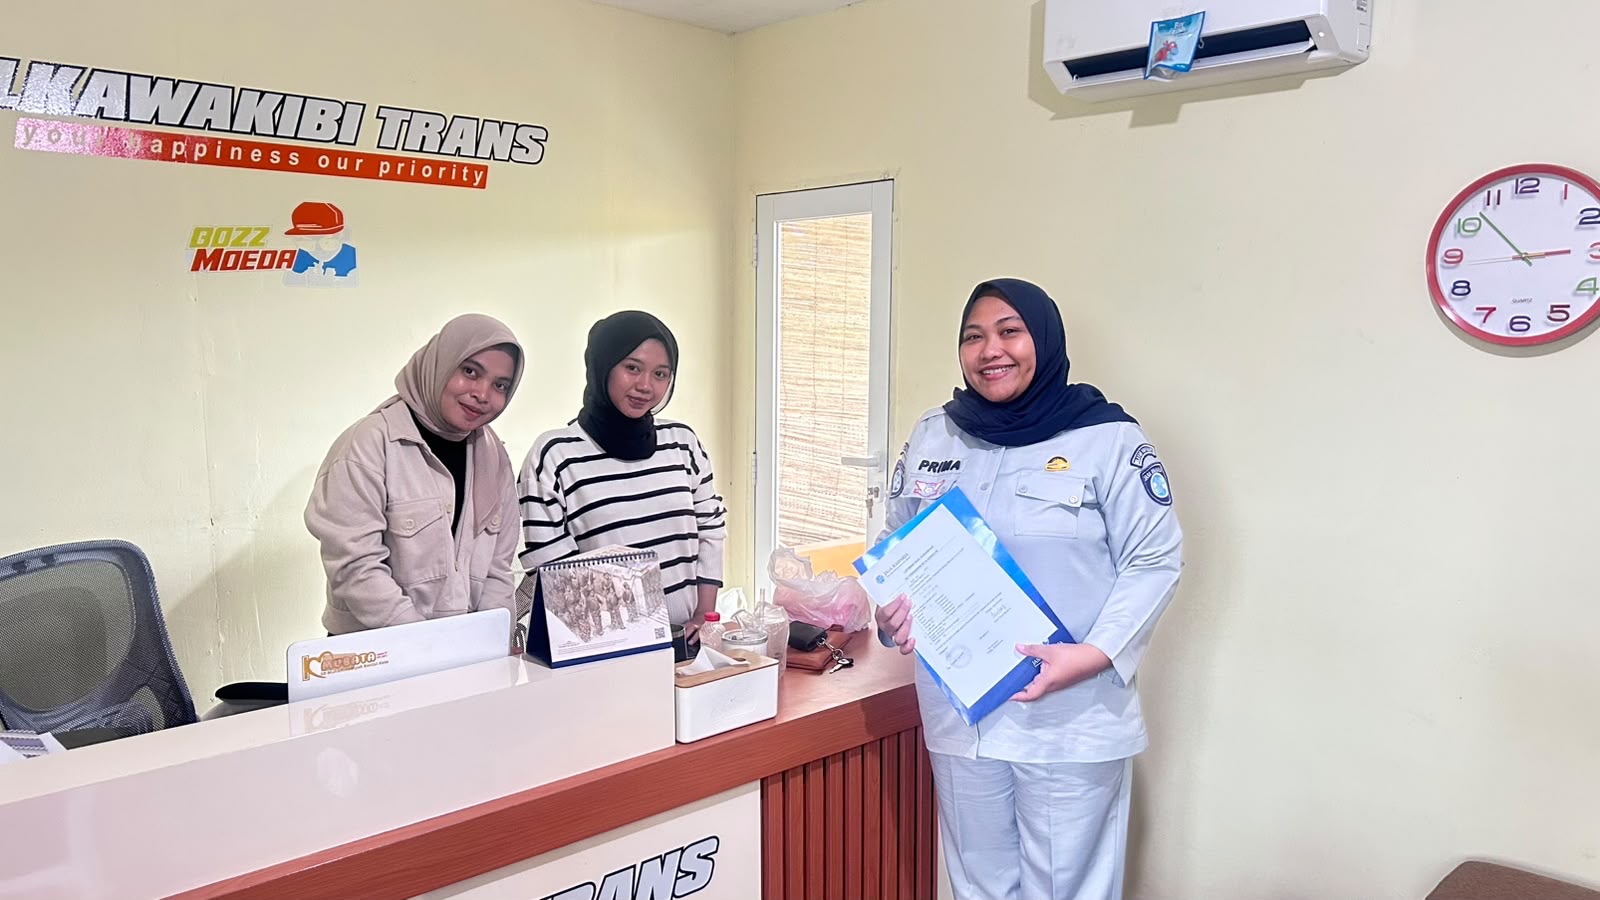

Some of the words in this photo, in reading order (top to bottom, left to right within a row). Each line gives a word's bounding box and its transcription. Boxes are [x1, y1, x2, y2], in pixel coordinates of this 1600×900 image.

[376, 106, 548, 165] TRANS
[125, 129, 300, 165] happiness
[317, 153, 364, 172] our
[379, 160, 484, 187] priority
[1515, 177, 1540, 194] 12
[1563, 184, 1568, 200] 1
[1486, 189, 1501, 206] 11
[1579, 207, 1600, 225] 2
[1457, 217, 1482, 233] 10
[188, 227, 271, 247] BOZZ
[190, 248, 297, 272] MOEDA
[1443, 248, 1464, 265] 9
[1451, 280, 1472, 296] 8
[1575, 277, 1599, 295] 4
[1475, 307, 1497, 324] 7
[1547, 304, 1571, 322] 5
[1509, 316, 1531, 332] 6
[917, 459, 961, 474] PRIMA
